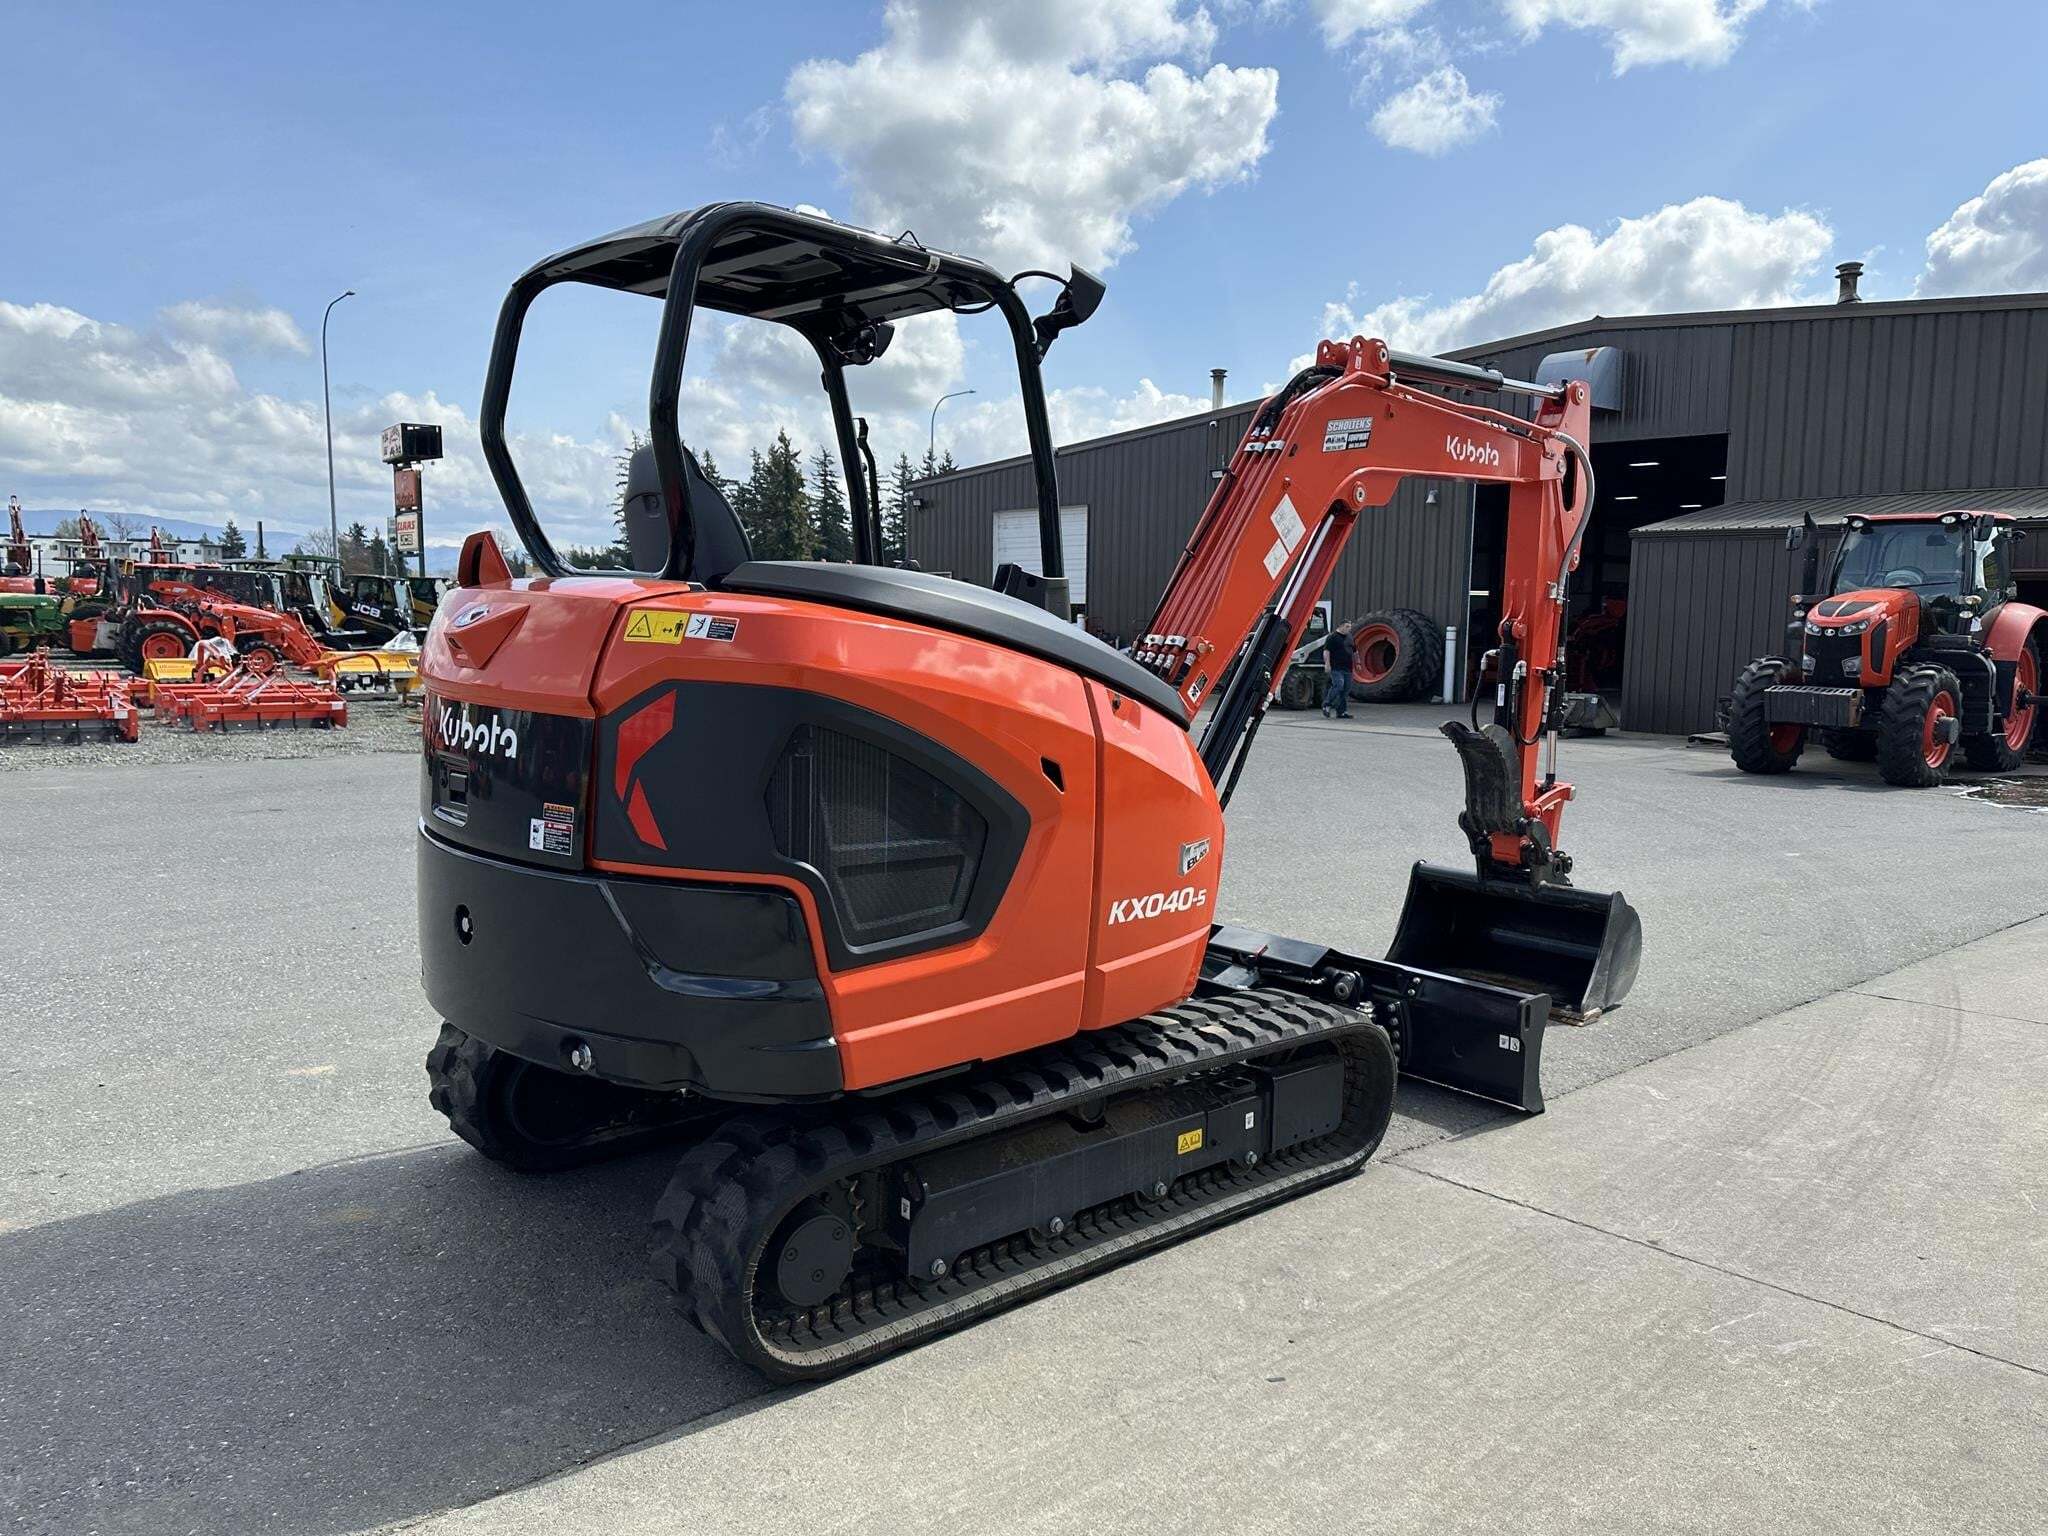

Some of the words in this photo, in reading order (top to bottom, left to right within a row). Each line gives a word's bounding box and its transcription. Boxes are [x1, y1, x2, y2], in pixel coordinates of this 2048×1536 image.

[1446, 434, 1499, 466] Kubota
[397, 520, 415, 531] CLAAS
[351, 602, 381, 618] JCB
[439, 705, 518, 758] Kubota
[1107, 887, 1207, 926] KX040-5
